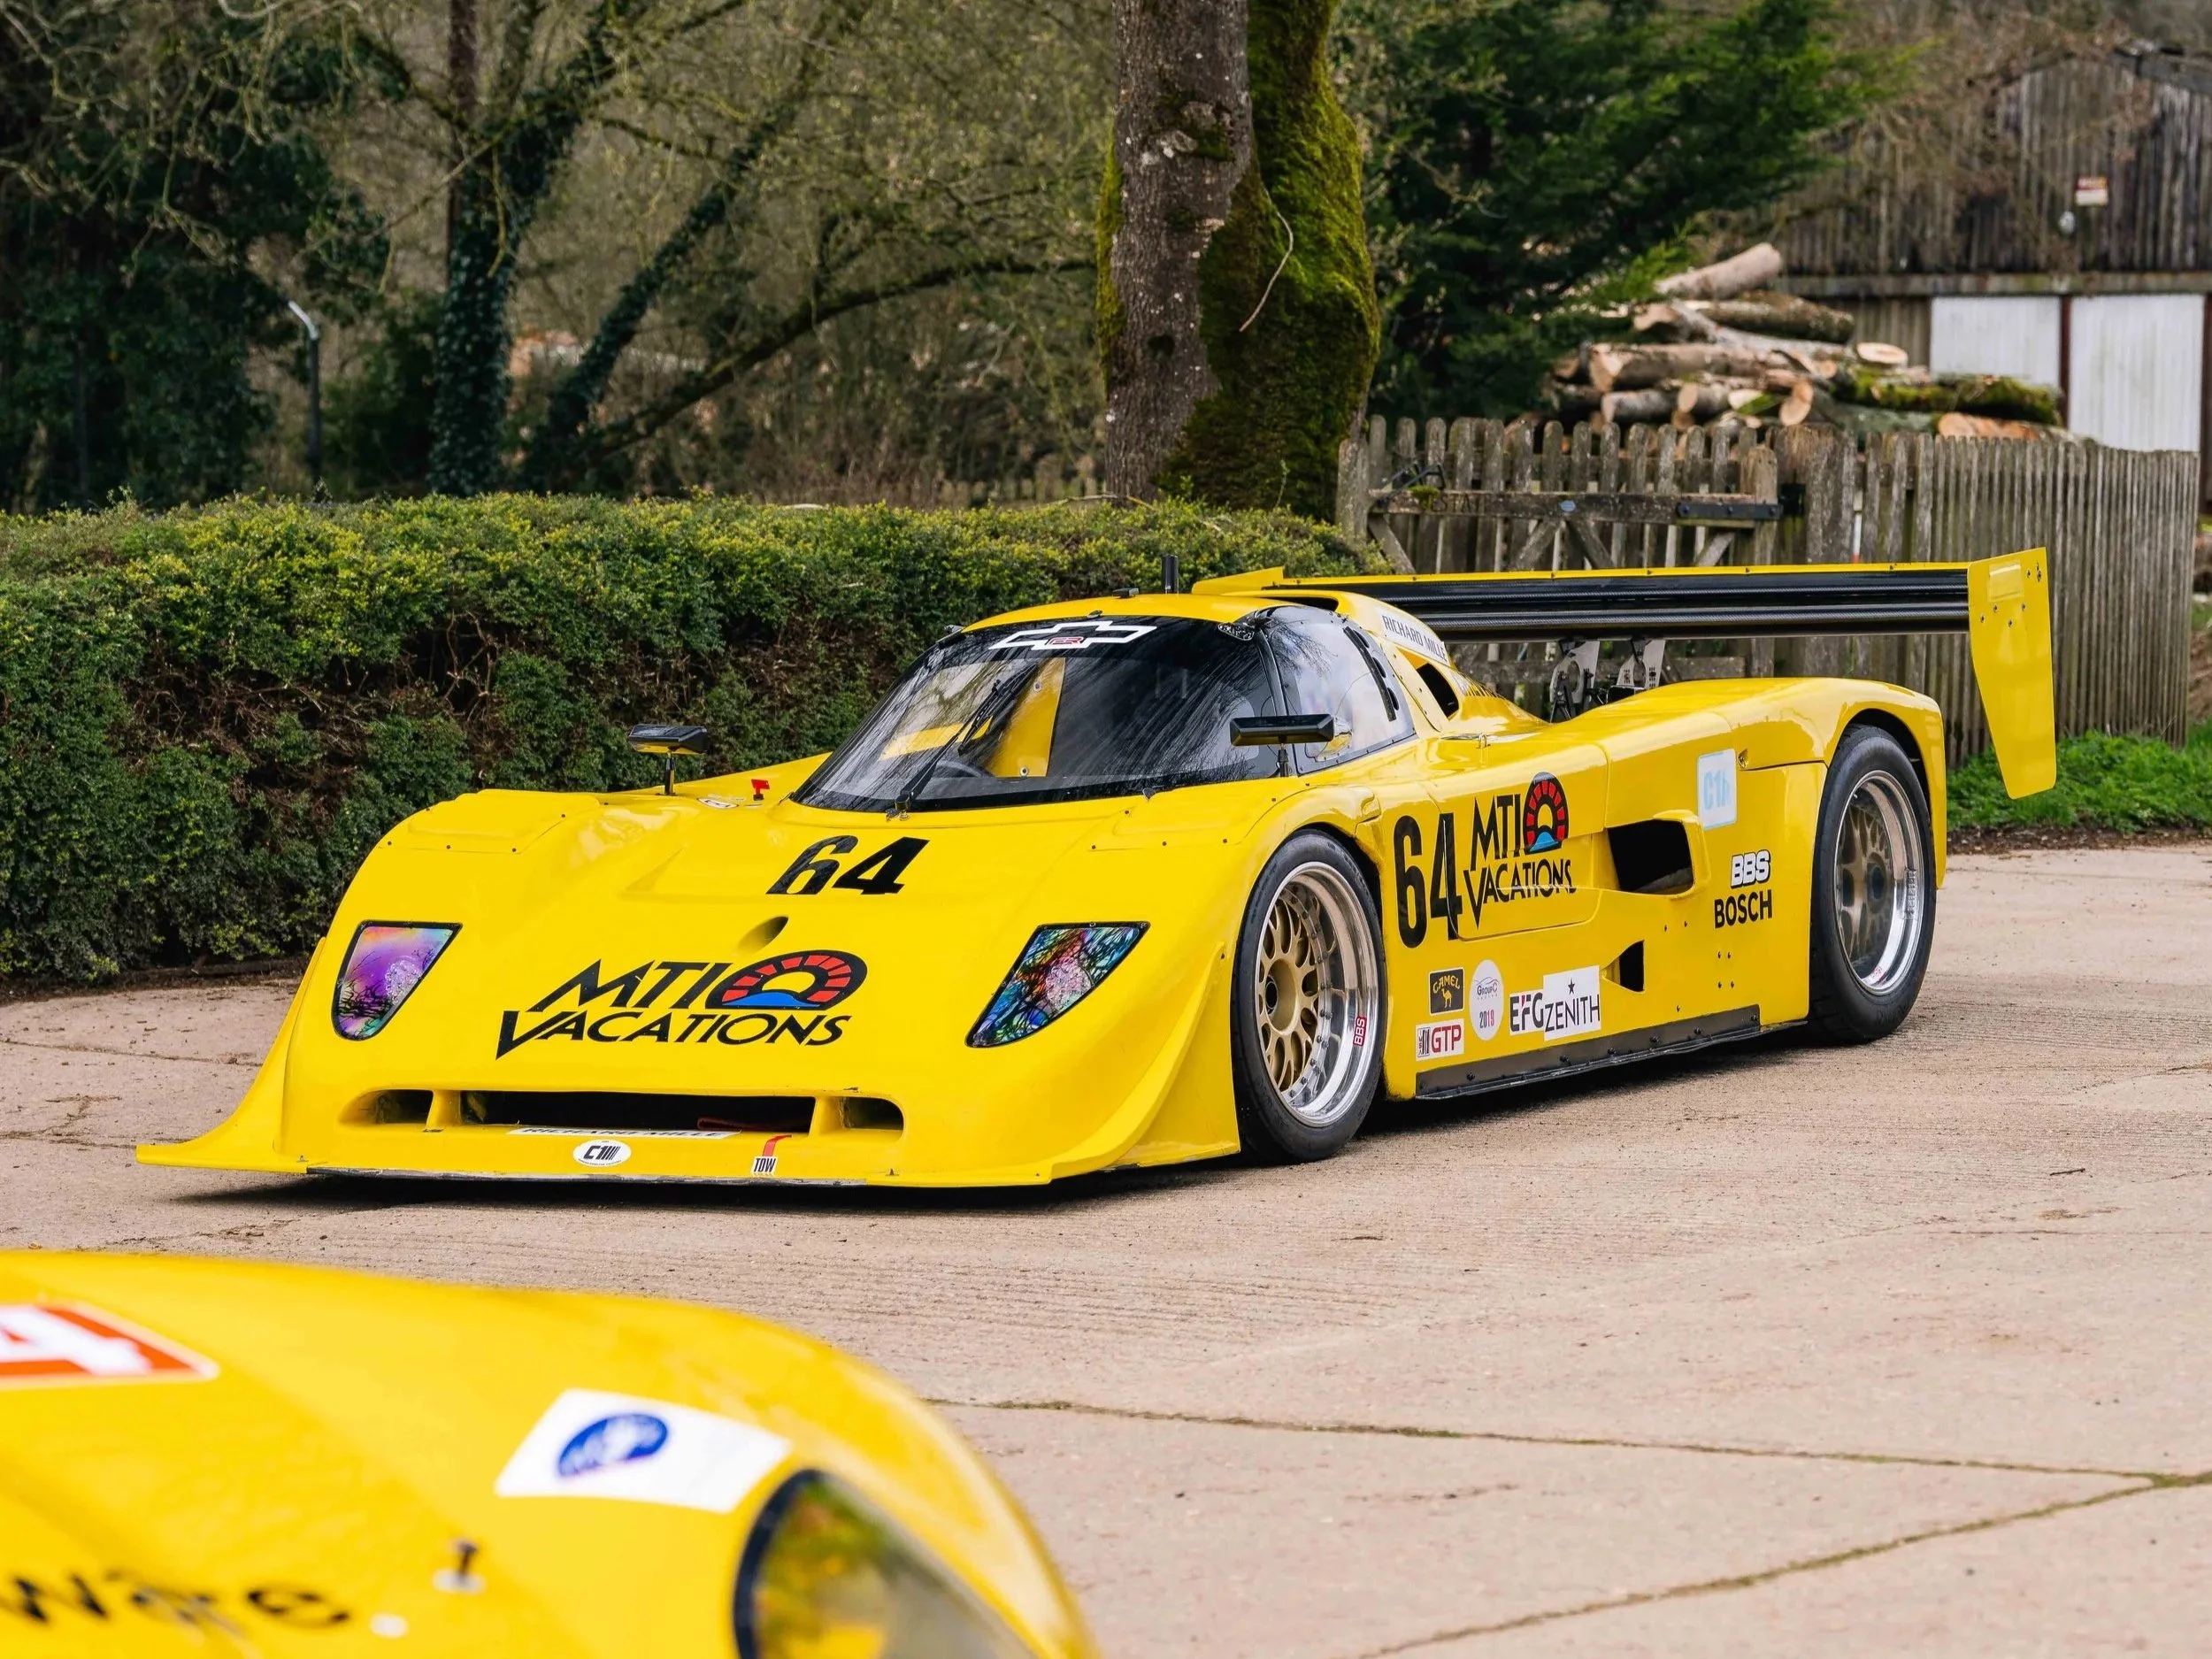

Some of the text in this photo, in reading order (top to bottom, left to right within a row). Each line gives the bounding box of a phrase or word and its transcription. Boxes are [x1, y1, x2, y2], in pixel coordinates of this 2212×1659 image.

[1381, 615, 1424, 647] RICHARD
[1471, 793, 1522, 872] MTI
[765, 834, 931, 895] 64
[1393, 812, 1463, 949] 64
[1731, 849, 1771, 889] BBS
[1463, 857, 1578, 930] VACATIONS
[1714, 889, 1773, 929] BOSCH
[525, 958, 733, 1012] MTI
[1432, 974, 1461, 994] CAMEL
[1354, 1017, 1366, 1046] BBS
[1479, 1009, 1494, 1029] 2019
[1509, 992, 1544, 1033] EFG
[1545, 994, 1600, 1033] ZENITH
[495, 1010, 853, 1061] VACATIONS
[1431, 1025, 1462, 1054] GTP
[753, 1157, 777, 1173] TOW
